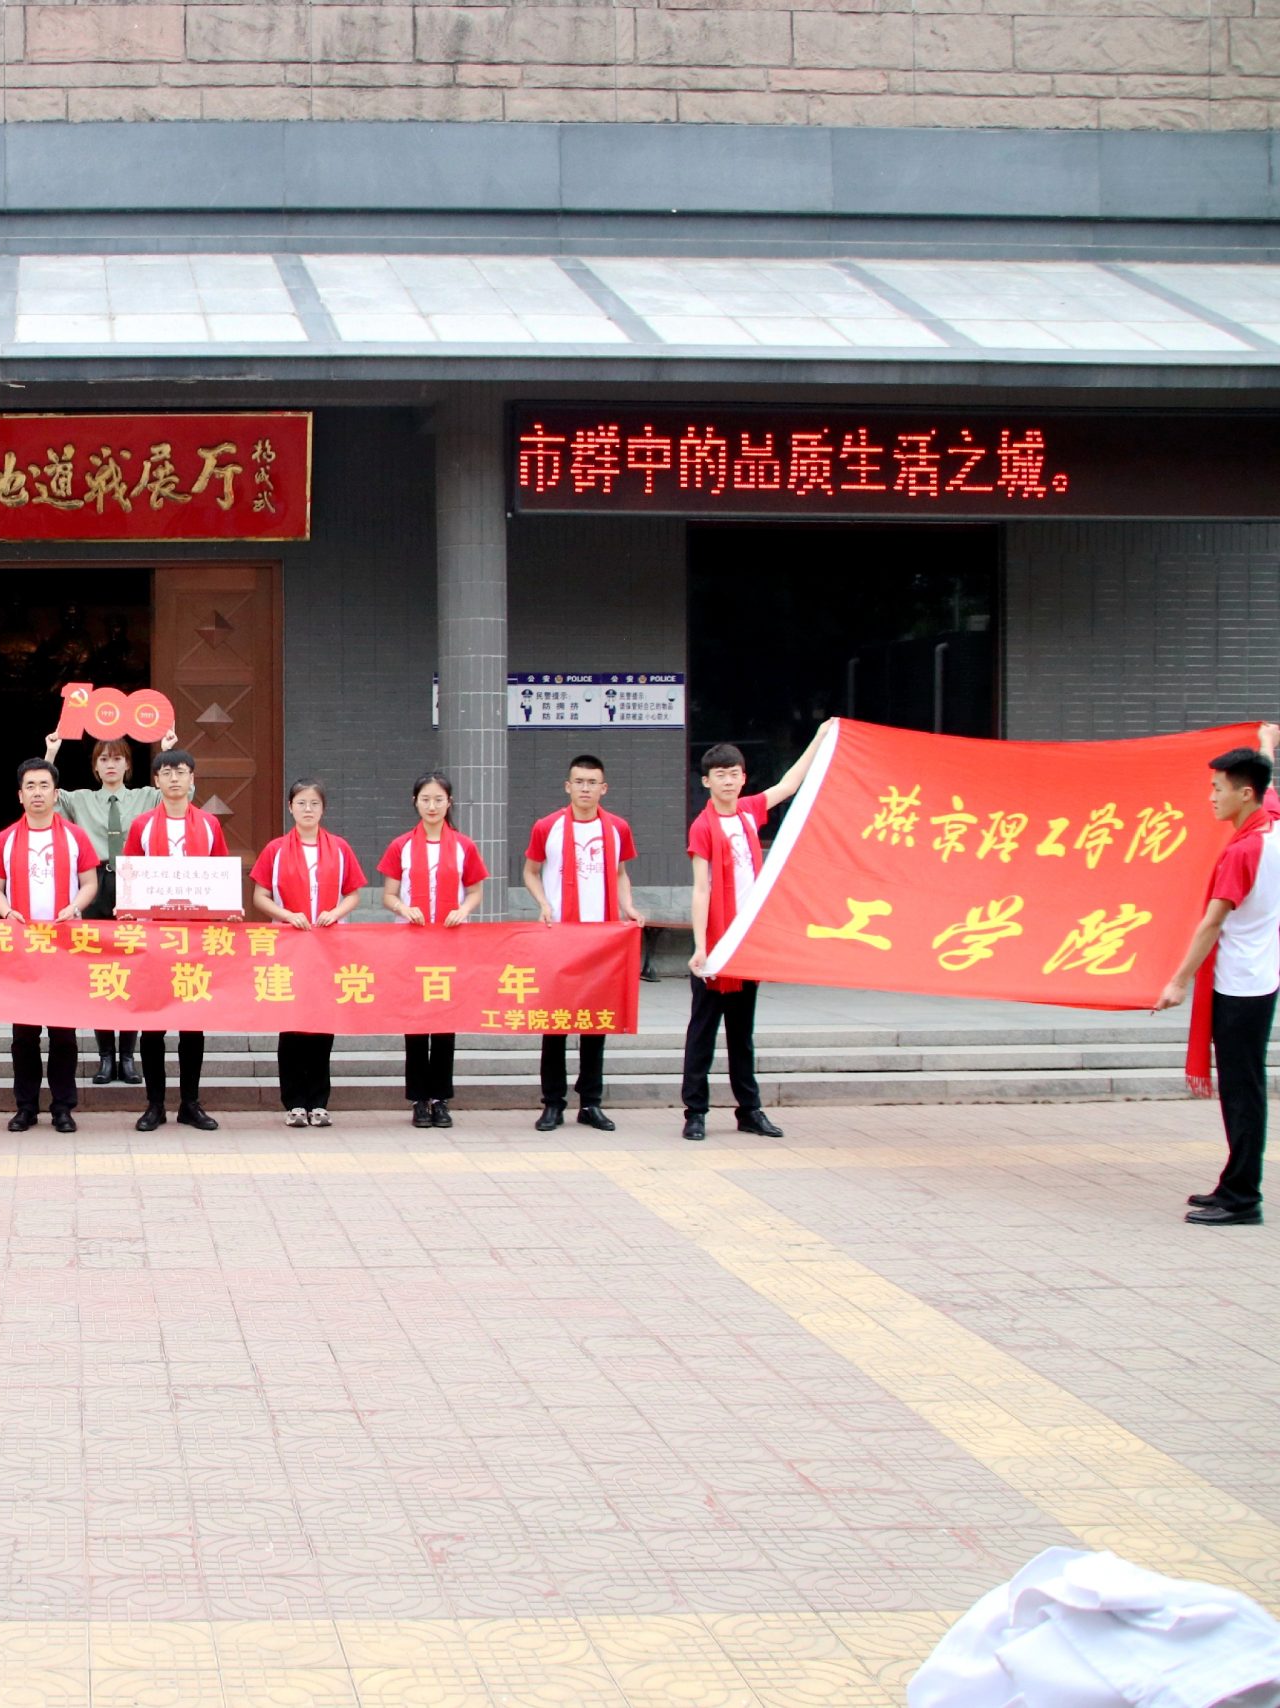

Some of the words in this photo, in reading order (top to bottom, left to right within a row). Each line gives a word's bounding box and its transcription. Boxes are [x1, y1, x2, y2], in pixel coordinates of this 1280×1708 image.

[520, 424, 1068, 498] 市群中的品质生活之城。
[861, 784, 1188, 869] 燕京理工学院
[806, 895, 1153, 976] 工学院
[89, 961, 541, 1004] 致敬建党百年
[480, 1009, 617, 1031] 工学院党总支
